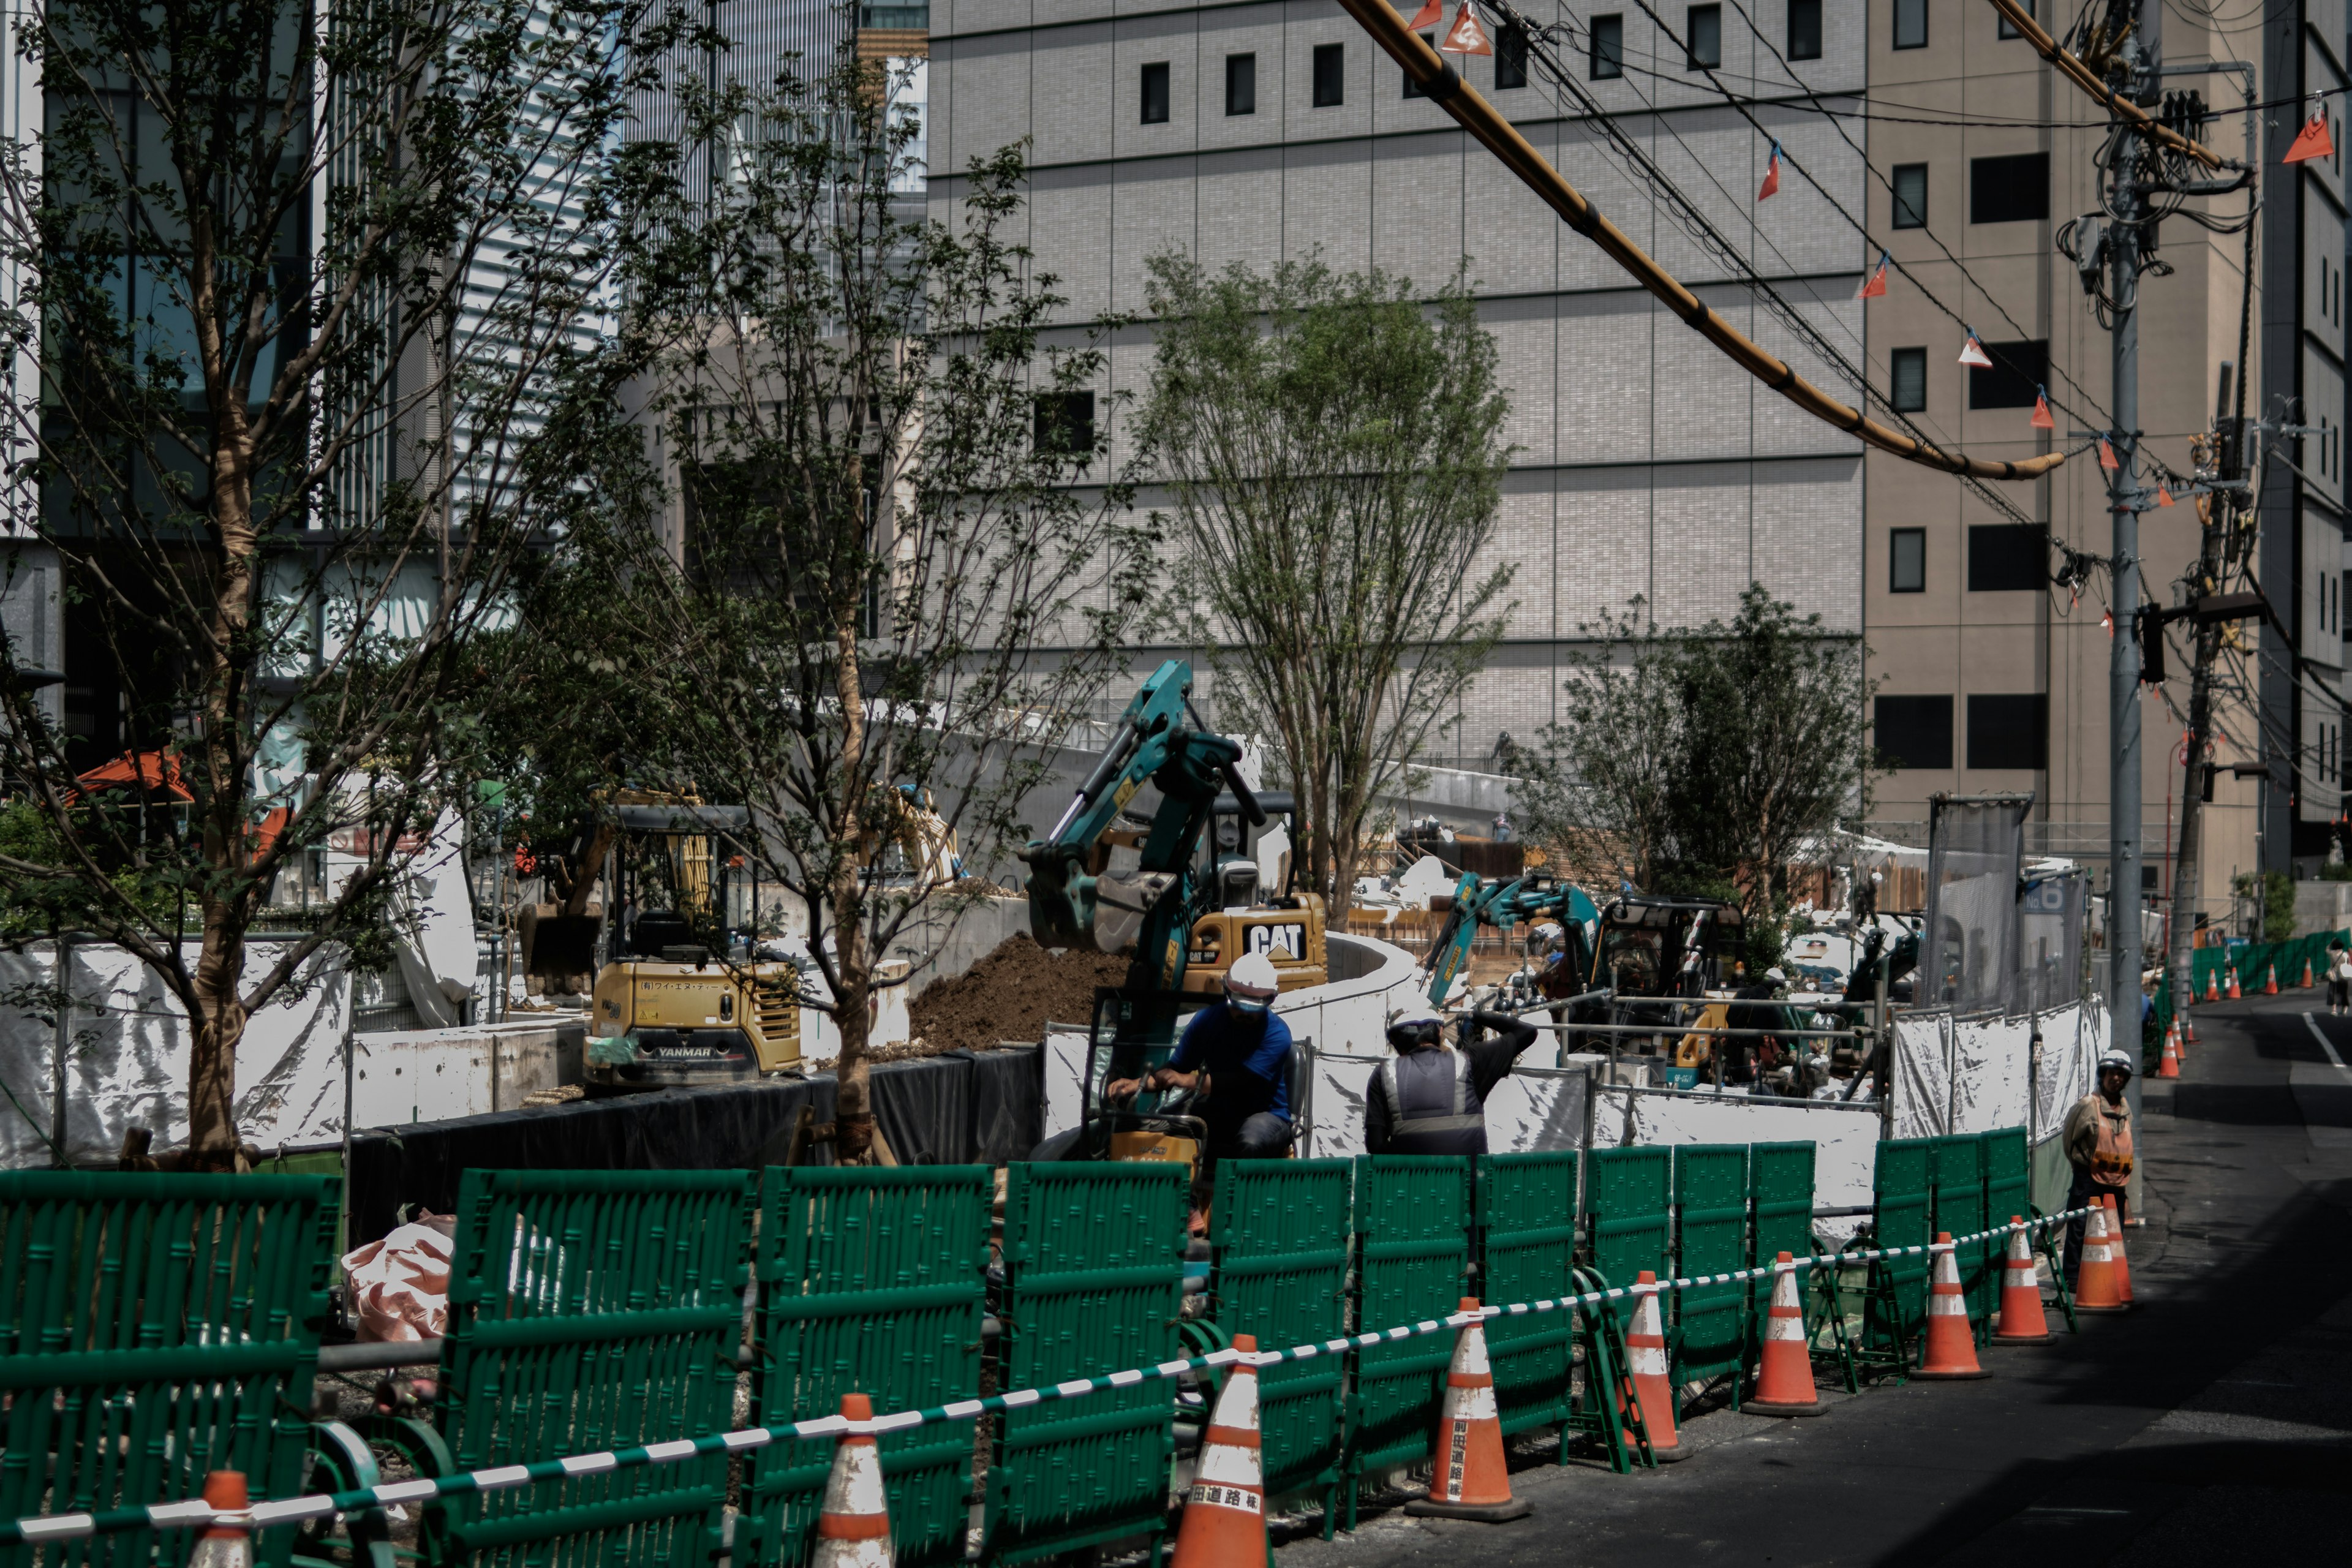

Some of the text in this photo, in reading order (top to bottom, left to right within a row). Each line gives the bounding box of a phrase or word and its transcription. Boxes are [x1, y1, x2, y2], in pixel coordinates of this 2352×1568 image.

[2027, 878, 2063, 909] No. 6
[1189, 952, 1202, 962] CAT
[1250, 925, 1301, 959] CAT
[659, 1048, 711, 1057] YANMAR
[1447, 1420, 1468, 1496] 前田道路(株)
